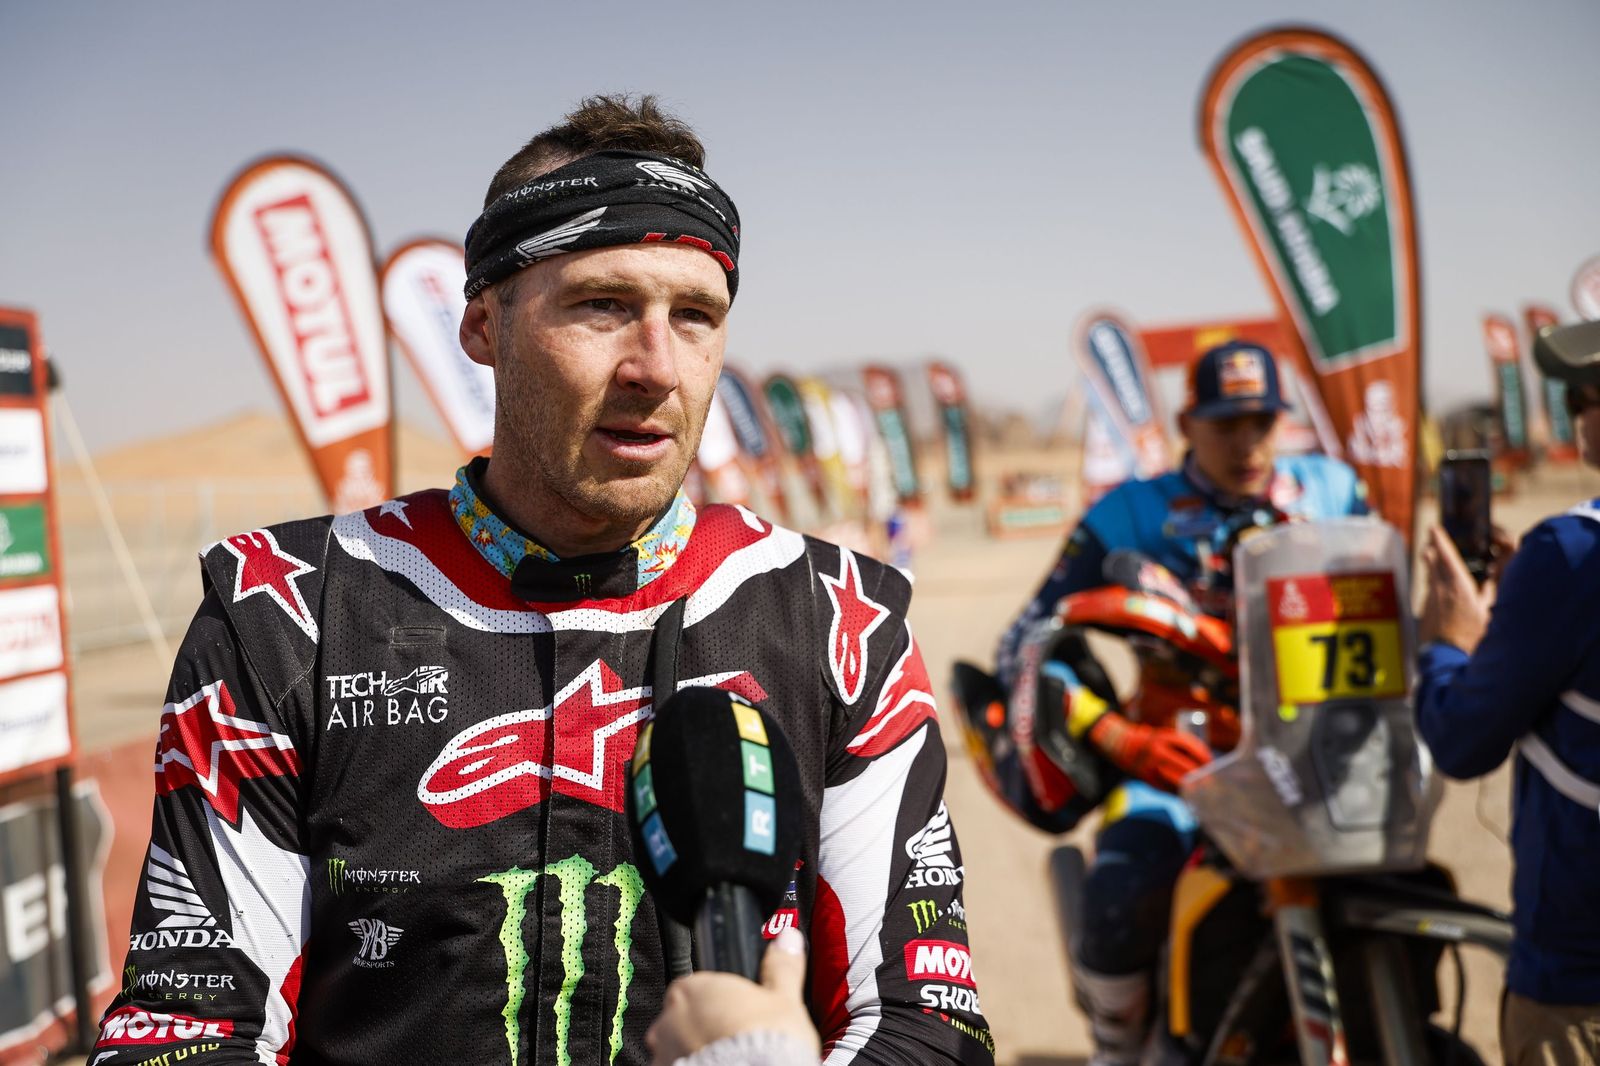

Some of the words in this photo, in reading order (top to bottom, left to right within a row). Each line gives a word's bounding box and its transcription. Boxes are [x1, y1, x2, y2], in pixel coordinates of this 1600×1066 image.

[259, 201, 368, 414] MOTUL
[1310, 631, 1375, 690] 73
[327, 700, 375, 731] AIR
[387, 696, 448, 725] BAG
[345, 867, 421, 884] MONSTER
[130, 929, 237, 951] HONDA
[101, 1011, 225, 1041] MOTUL
